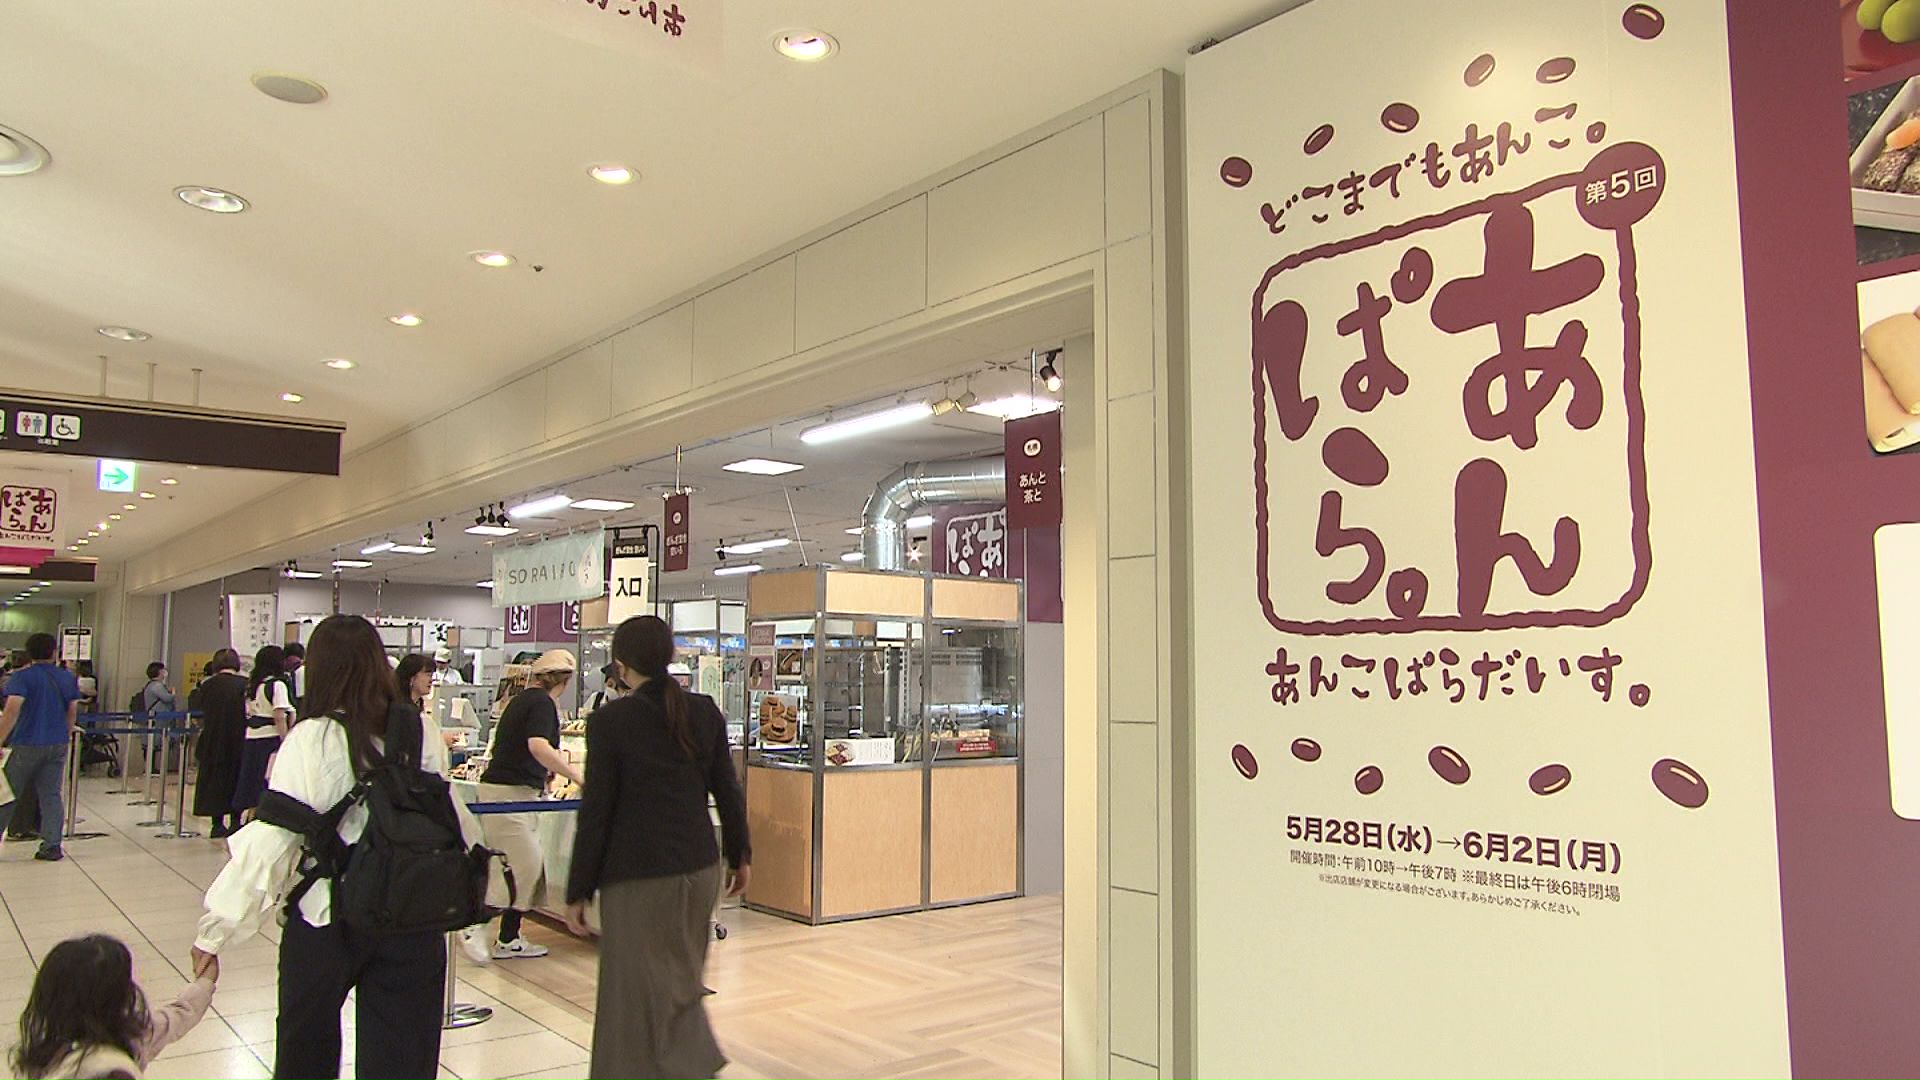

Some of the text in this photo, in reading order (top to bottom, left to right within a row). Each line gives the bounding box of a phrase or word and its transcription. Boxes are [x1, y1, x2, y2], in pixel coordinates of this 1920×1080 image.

[1260, 103, 1606, 233] どこまでもあんこ。
[1584, 164, 1657, 206] 第5回
[1019, 471, 1046, 488] あんと
[1023, 489, 1042, 504] 茶と
[616, 577, 642, 597] 入口
[1265, 647, 1651, 708] あんこぱらだいす。
